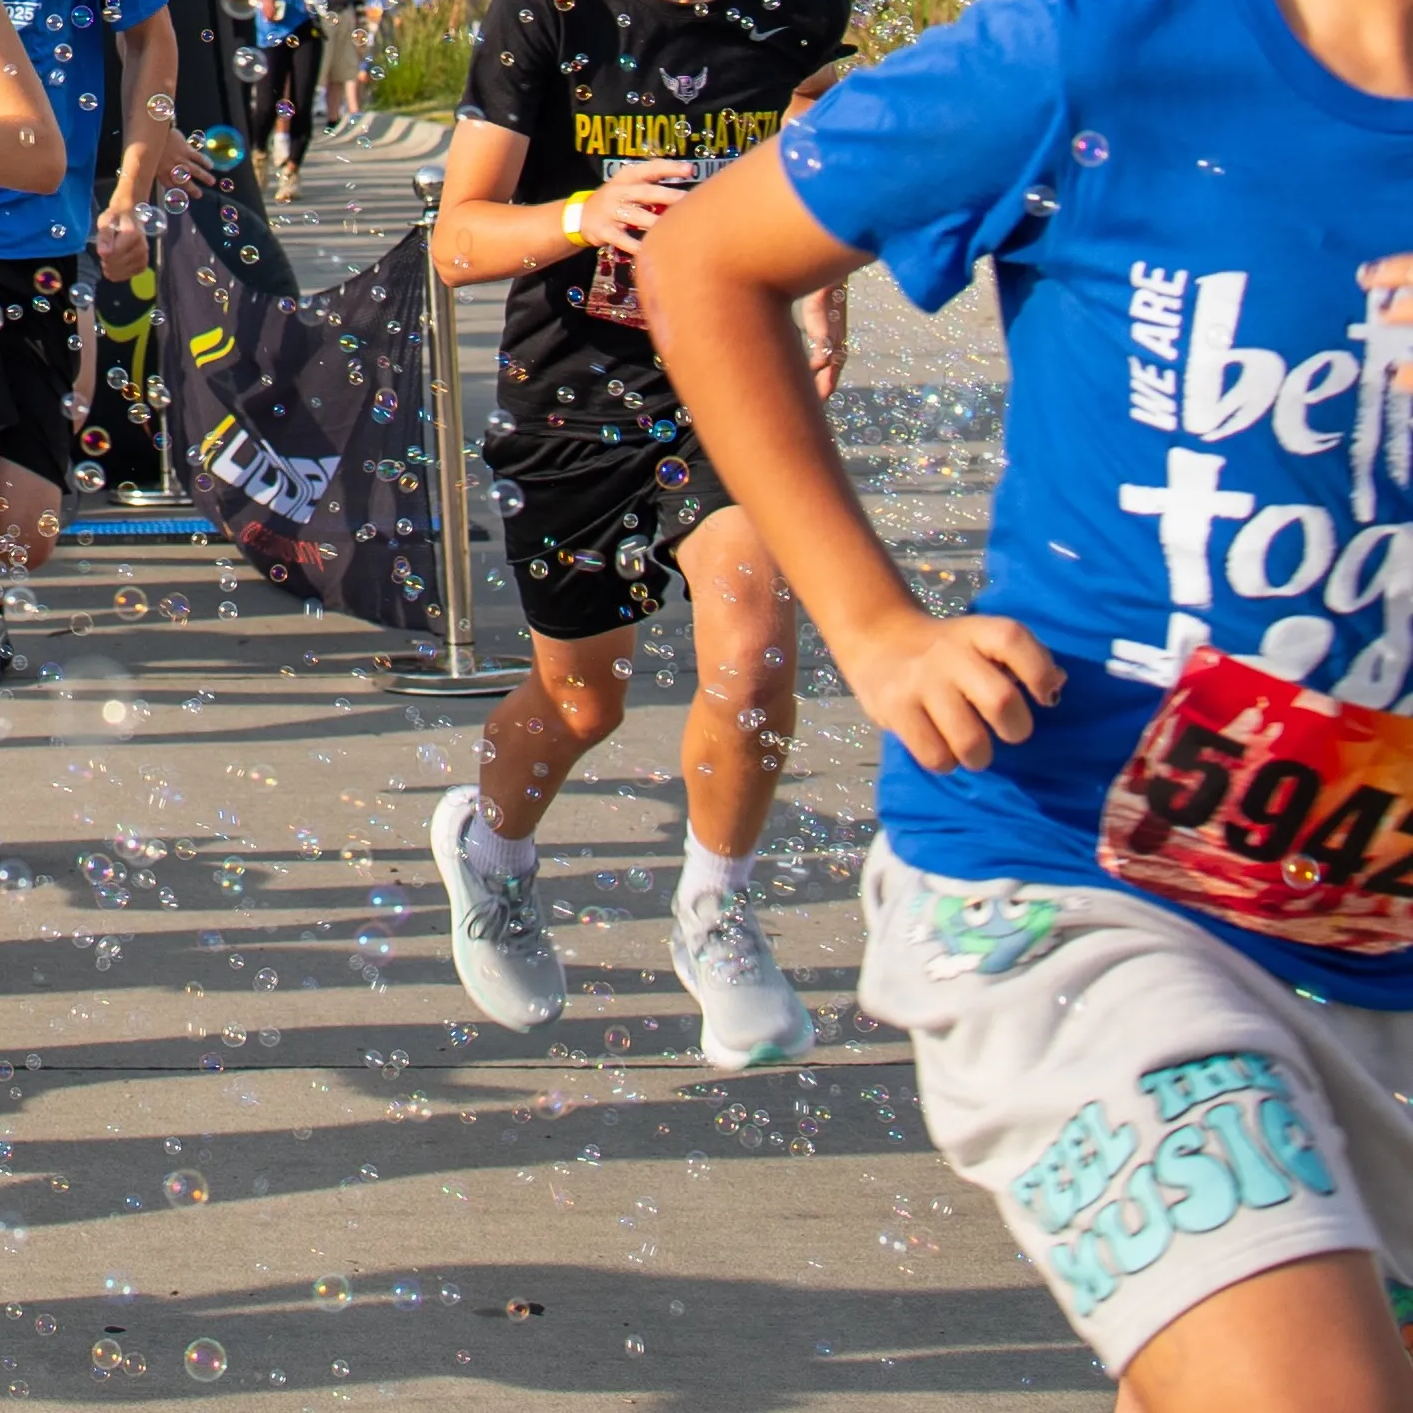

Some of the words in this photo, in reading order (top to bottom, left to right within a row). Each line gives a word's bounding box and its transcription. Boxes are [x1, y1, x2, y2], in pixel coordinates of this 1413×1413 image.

[575, 113, 687, 156] PAPILLION
[1129, 260, 1189, 361] ARE
[1128, 354, 1177, 432] WE
[1011, 1099, 1139, 1235] FEEL
[1049, 1096, 1337, 1317] MUSIC
